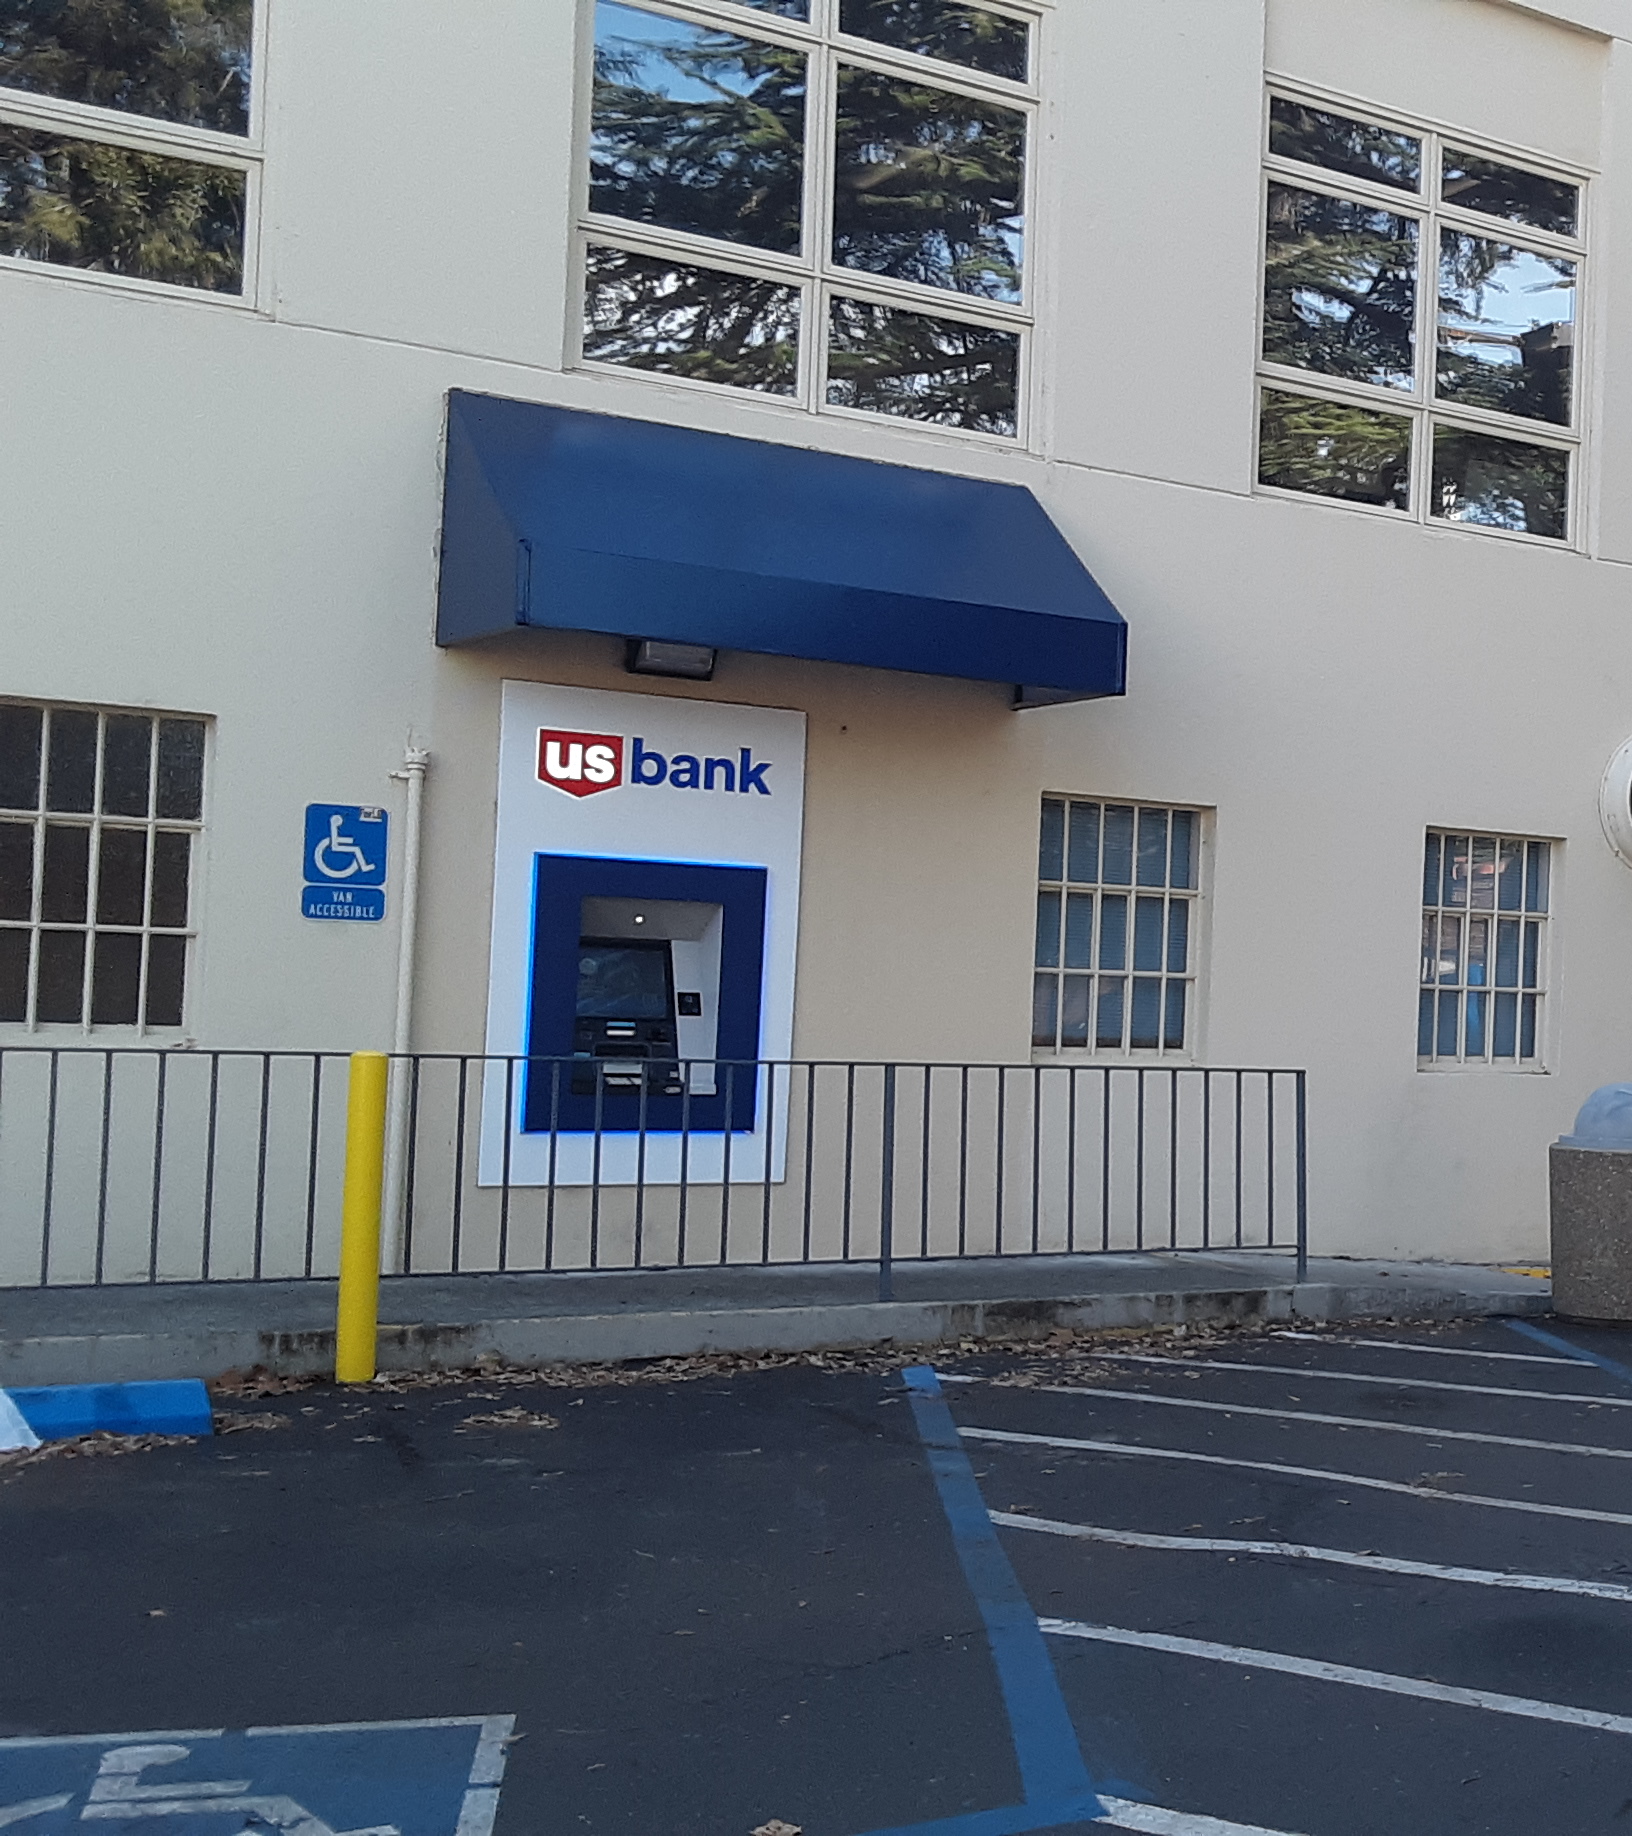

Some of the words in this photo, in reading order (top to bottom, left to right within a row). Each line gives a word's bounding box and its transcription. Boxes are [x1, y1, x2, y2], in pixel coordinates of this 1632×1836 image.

[545, 740, 616, 783] us
[631, 736, 773, 796] bank
[332, 891, 353, 903] VAN
[308, 905, 375, 918] ACCESSIBLE
